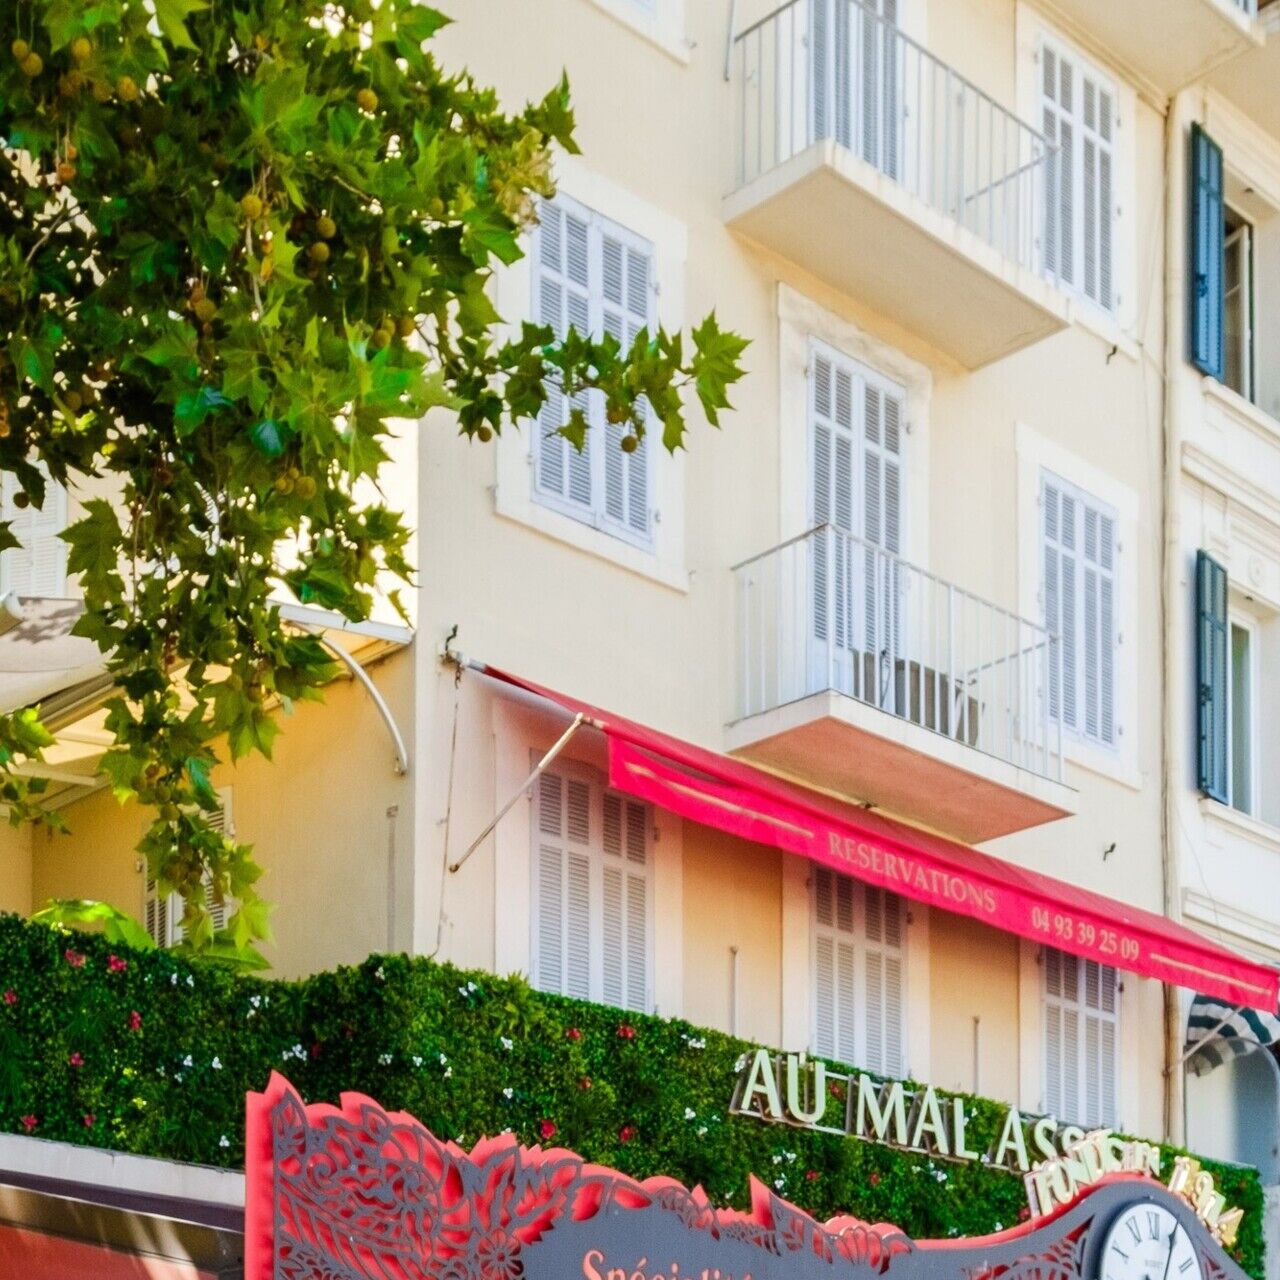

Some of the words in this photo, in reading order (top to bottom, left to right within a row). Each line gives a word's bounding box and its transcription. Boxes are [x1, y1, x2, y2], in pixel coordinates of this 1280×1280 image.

[827, 831, 998, 914] RESERVATIONS
[1031, 906, 1051, 933] 04
[1054, 914, 1074, 940] 93
[1076, 921, 1097, 948] 39
[1098, 929, 1118, 955] 25
[1120, 936, 1140, 962] 09
[740, 1048, 827, 1125] AU
[856, 1073, 980, 1161] MAL
